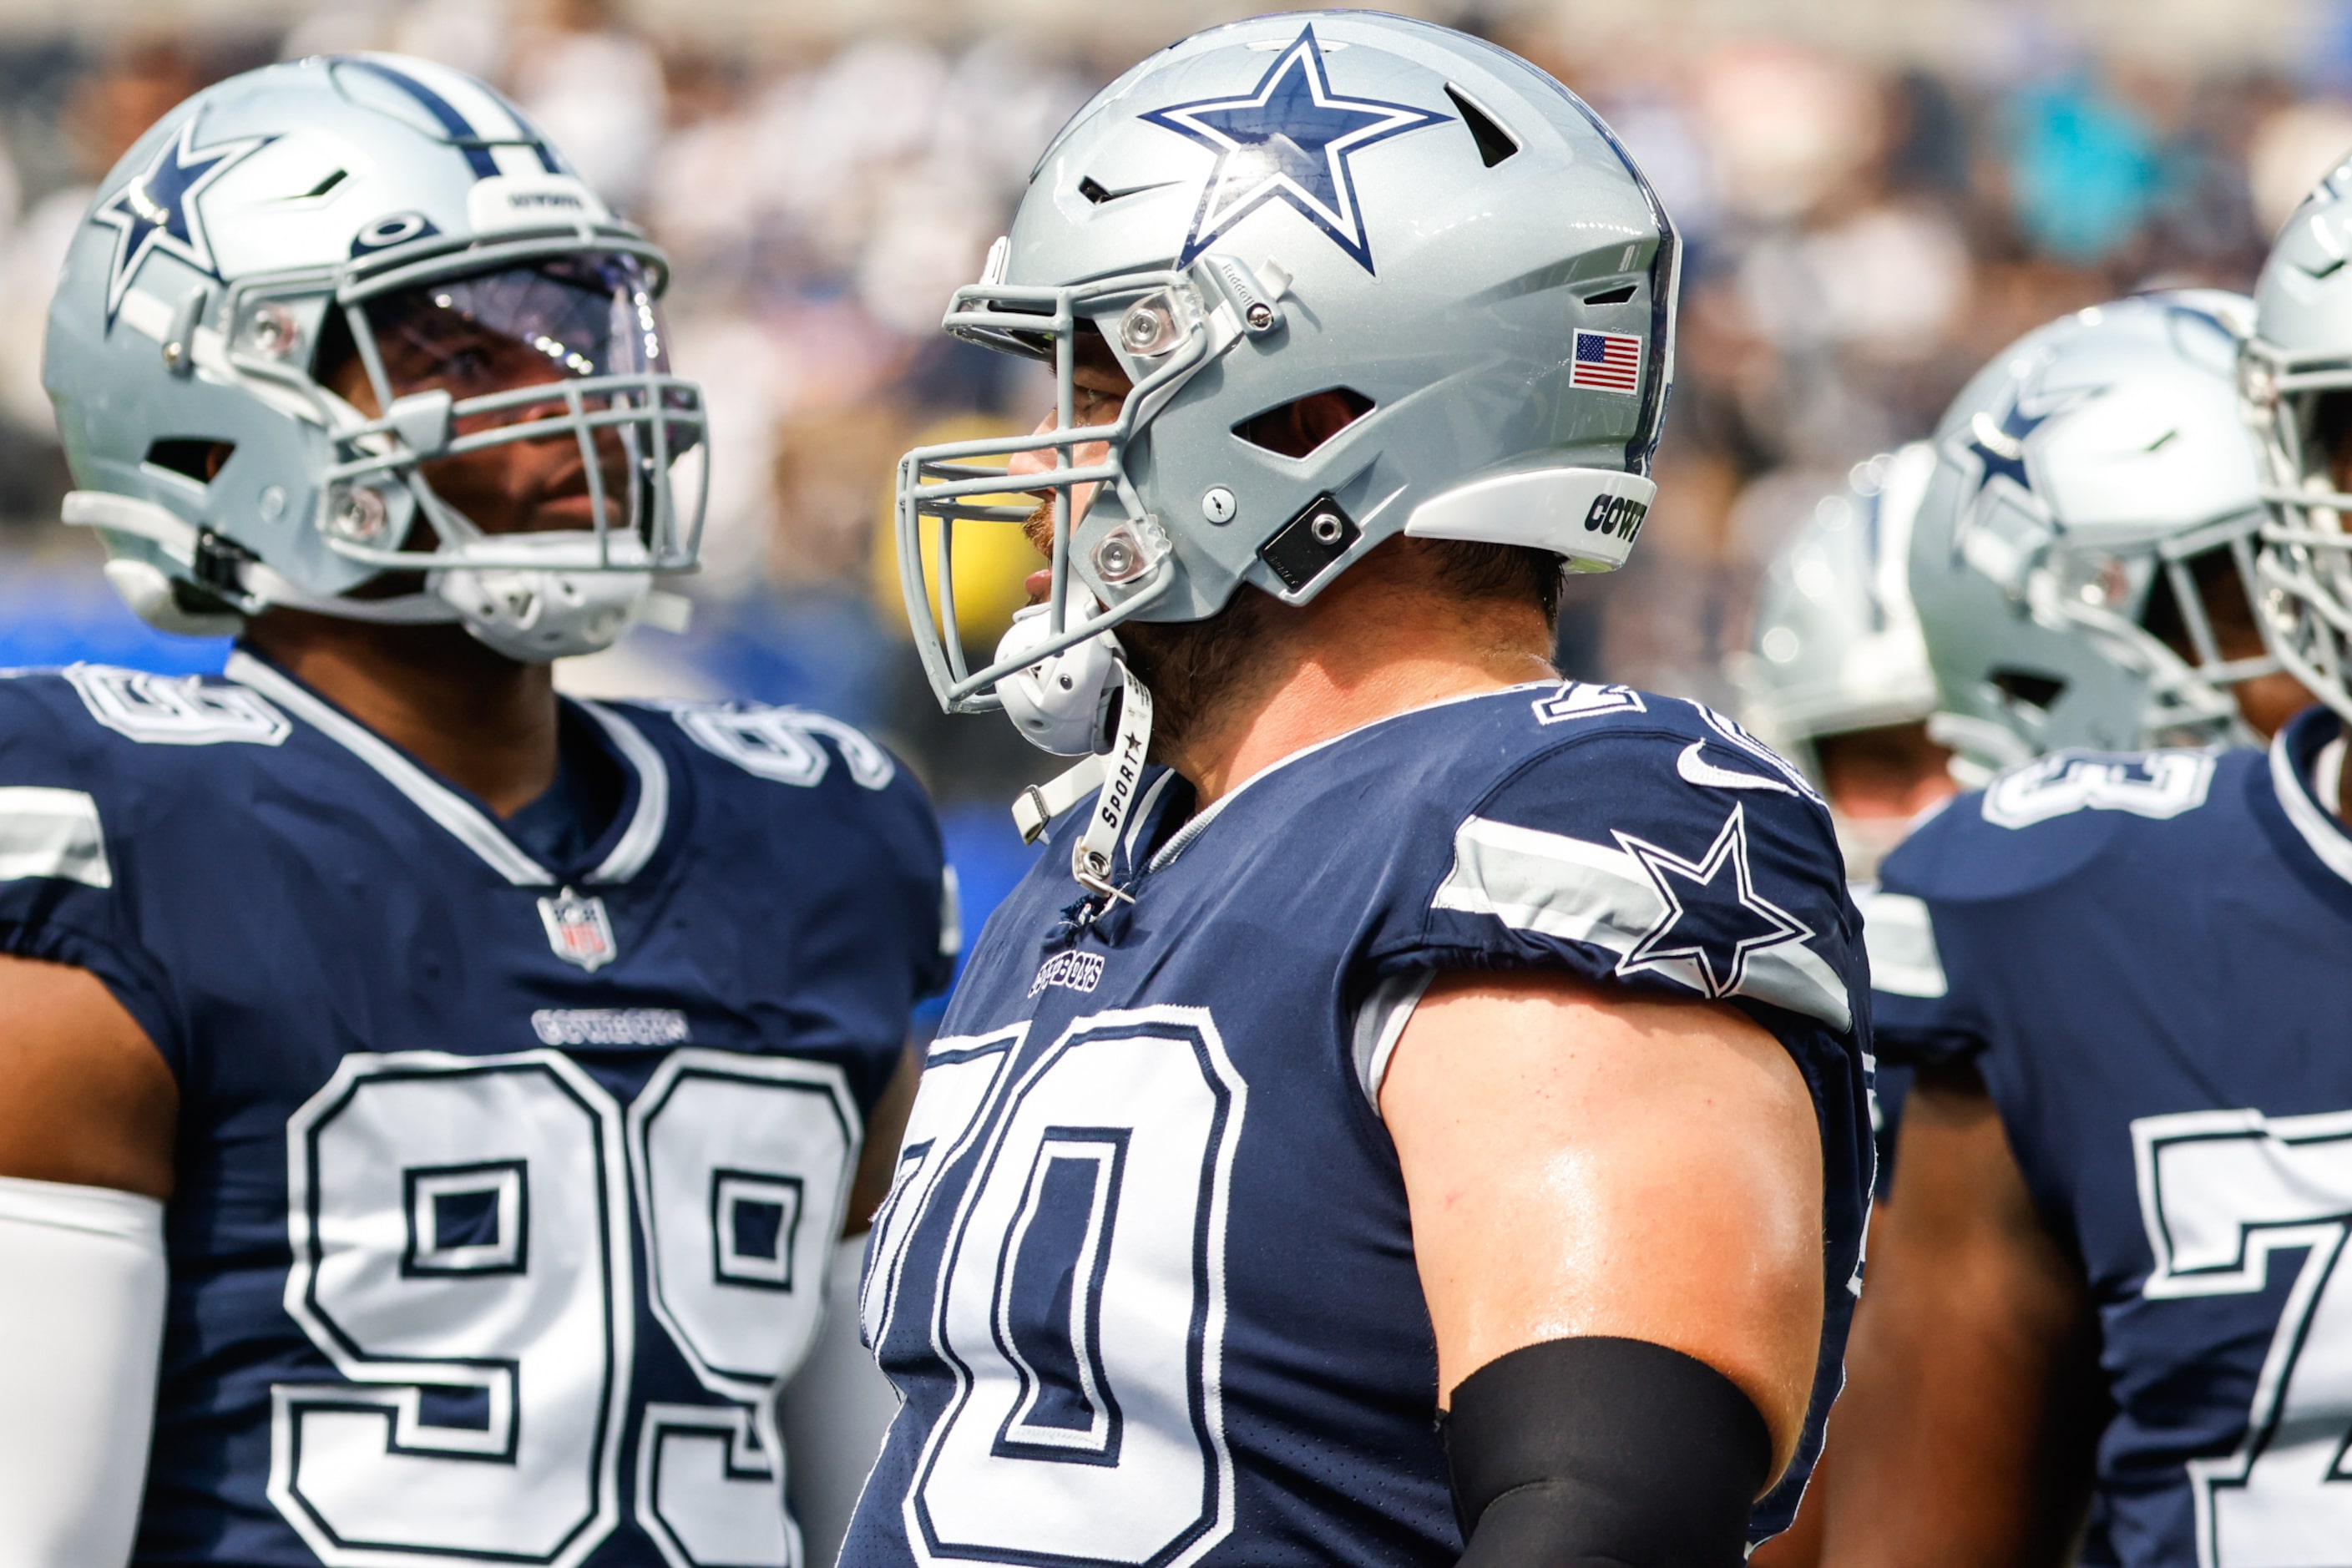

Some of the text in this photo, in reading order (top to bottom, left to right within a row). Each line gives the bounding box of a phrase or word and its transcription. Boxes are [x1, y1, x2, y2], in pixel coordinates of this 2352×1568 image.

[1222, 263, 1256, 308] Riddell
[1101, 750, 1139, 829] SPORT
[266, 1049, 865, 1568] 99
[861, 1004, 1248, 1568] 70
